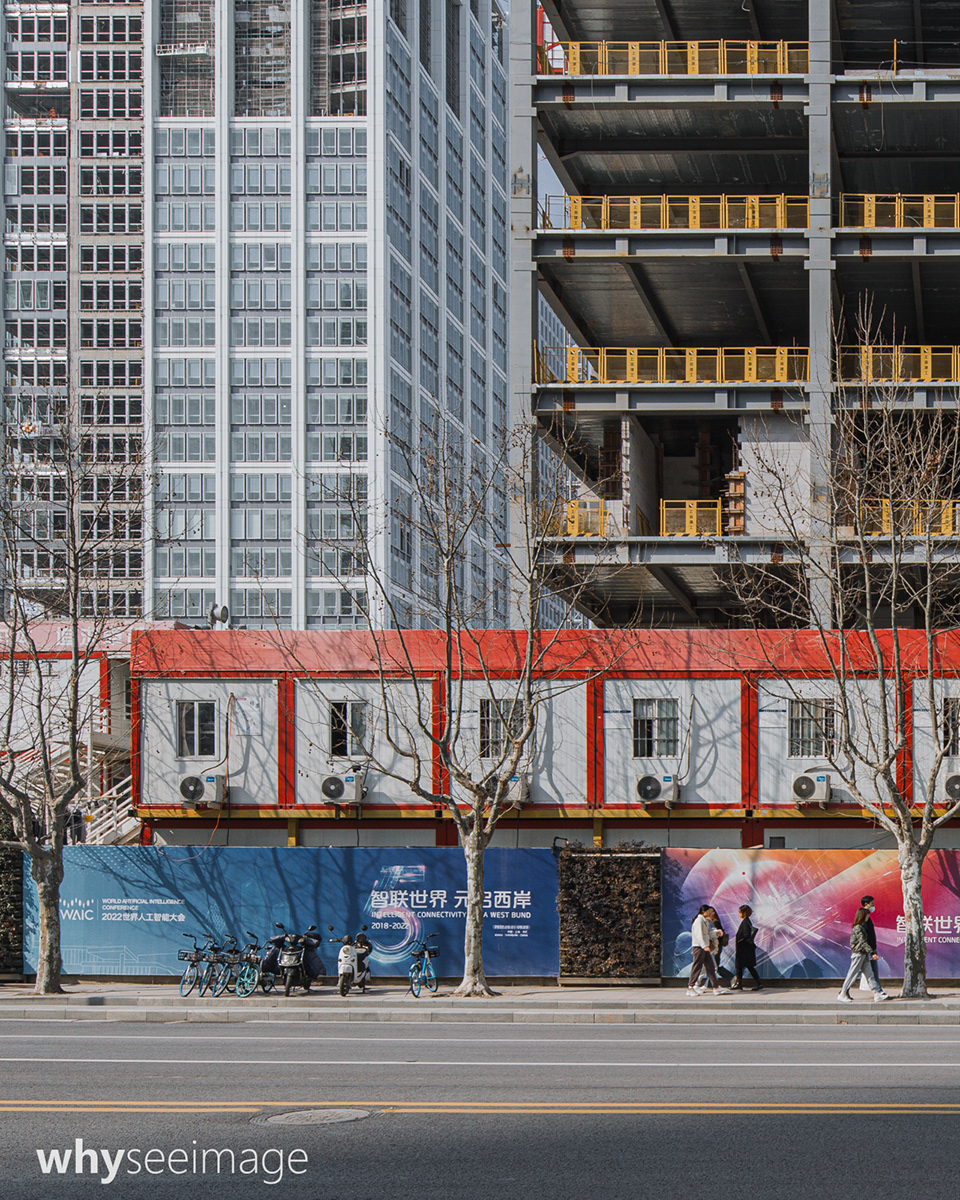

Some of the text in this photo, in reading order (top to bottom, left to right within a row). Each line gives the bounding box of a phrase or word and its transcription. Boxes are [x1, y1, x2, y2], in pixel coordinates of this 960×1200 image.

[0, 660, 58, 677] 建工
[371, 889, 448, 909] 智联世界
[60, 909, 94, 921] WAIC
[102, 912, 186, 922] 2022世界人工智能大会
[490, 911, 510, 919] WEST
[511, 911, 532, 919] BUND
[371, 922, 410, 930] 2018-2022
